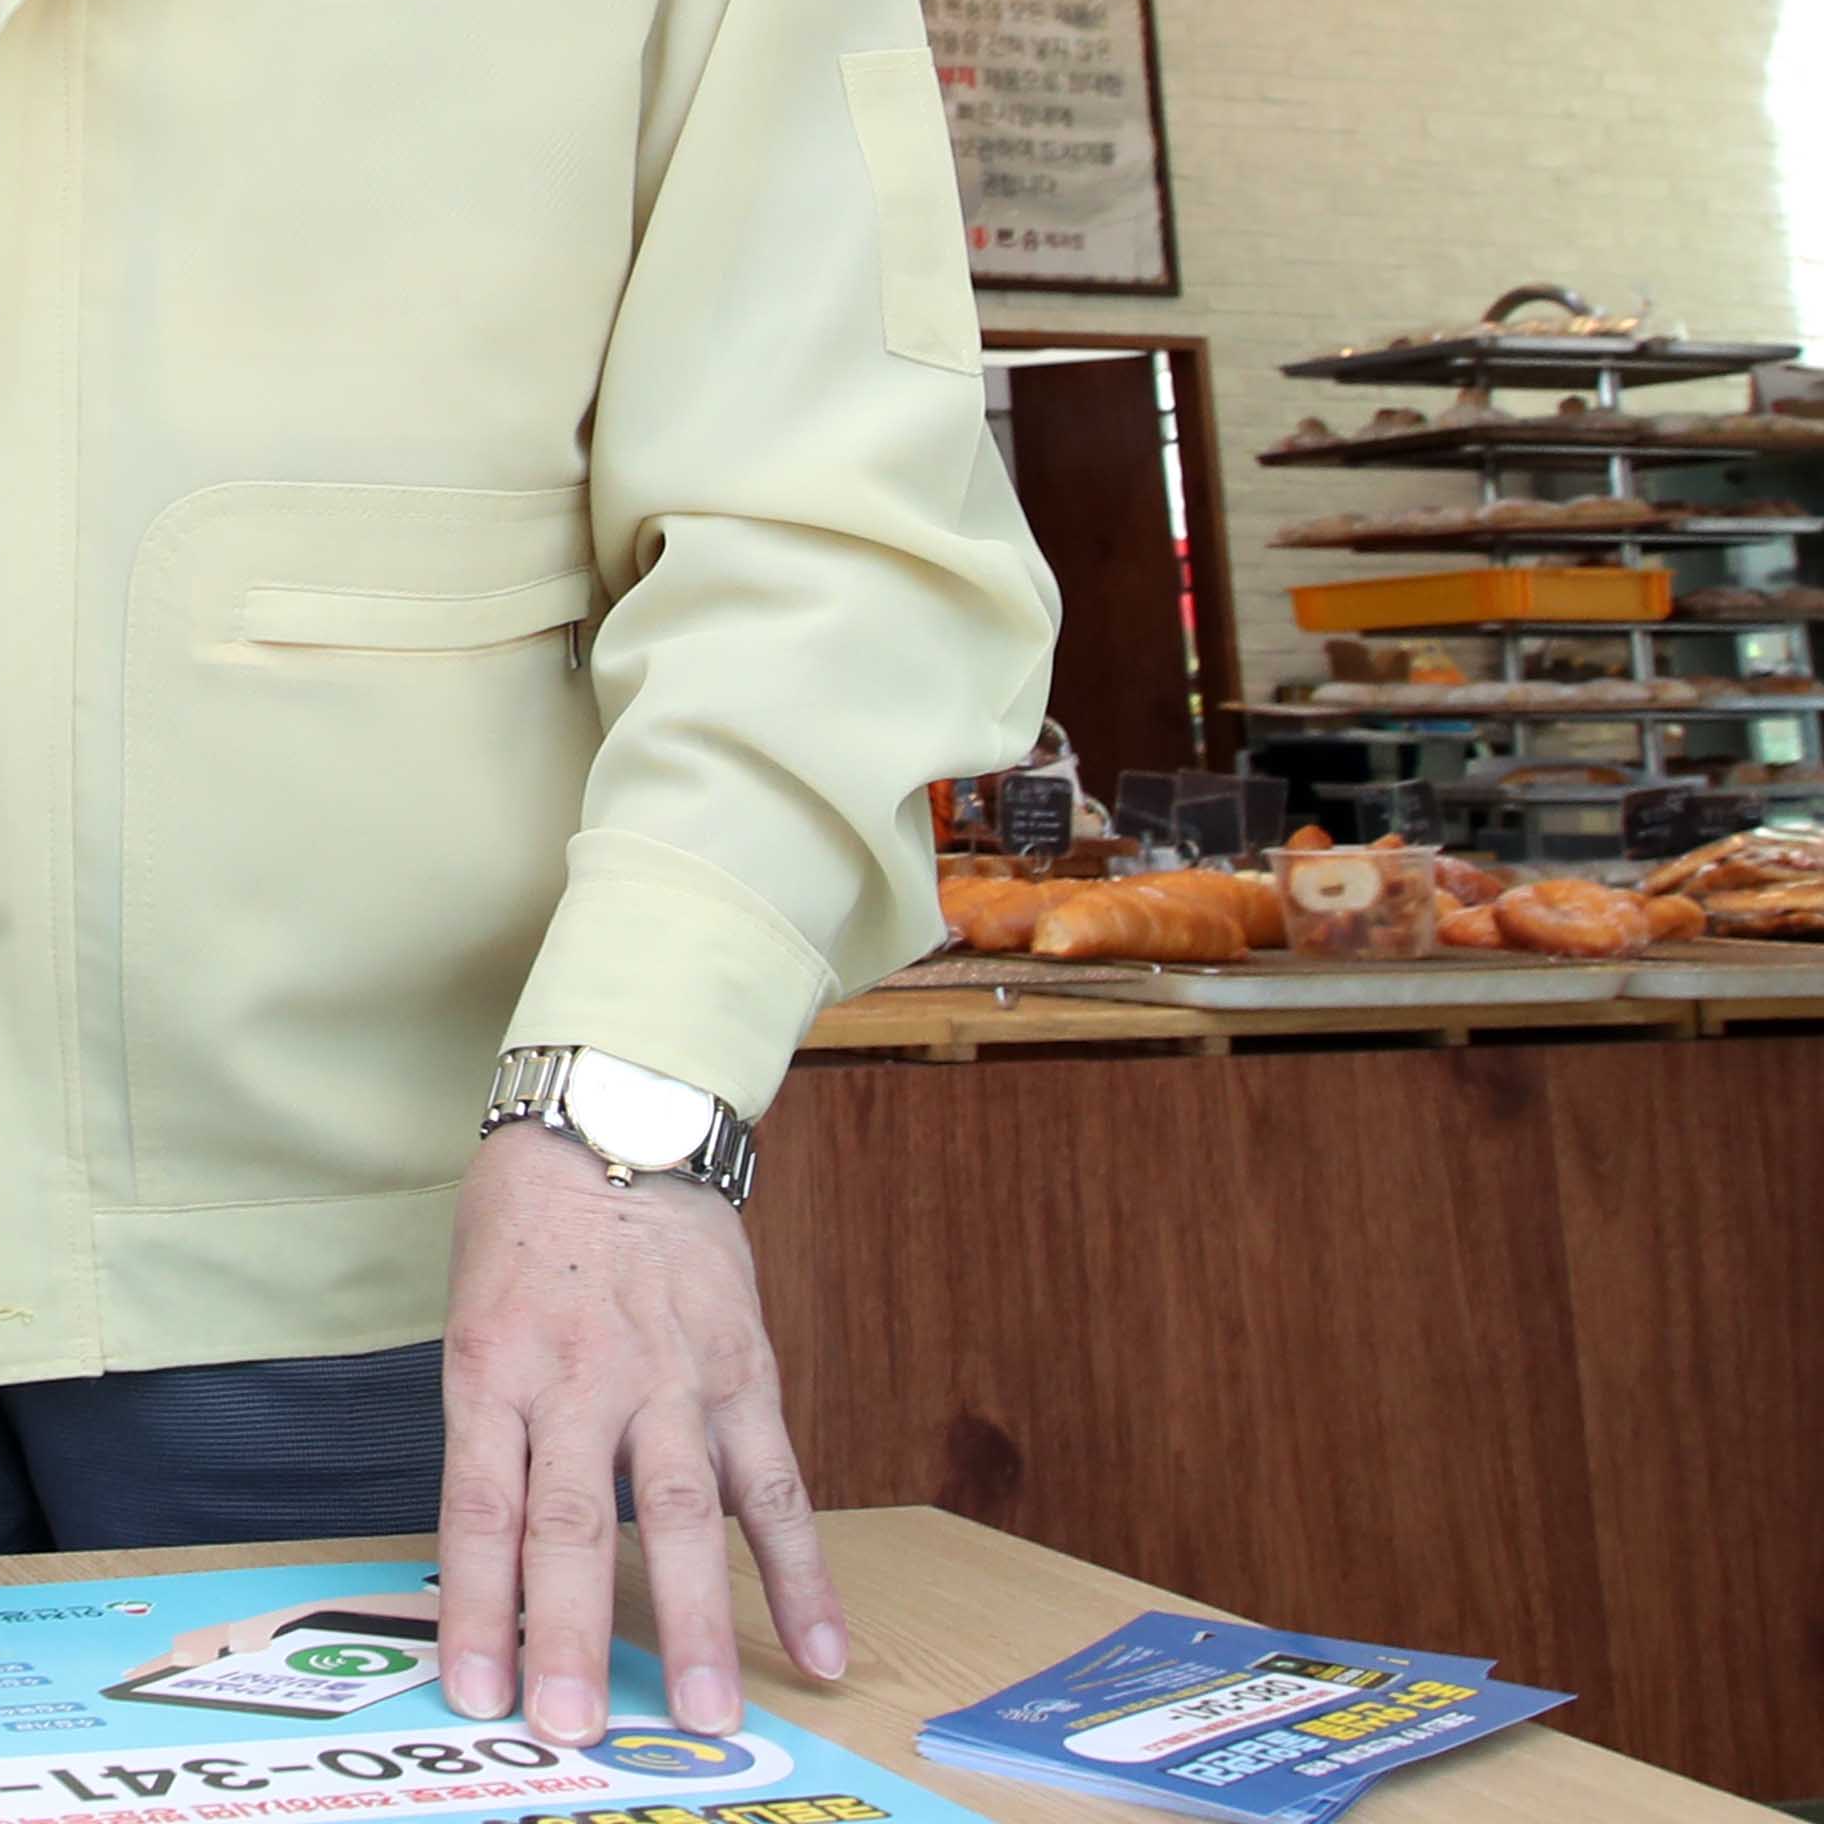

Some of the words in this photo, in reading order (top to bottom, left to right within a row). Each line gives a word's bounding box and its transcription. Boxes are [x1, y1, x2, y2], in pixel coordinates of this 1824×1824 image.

[1388, 1679, 1479, 1711] 동구
[1291, 1700, 1419, 1742] 안심콜
[398, 1781, 527, 1804] 번호로
[523, 1776, 609, 1794] 아래
